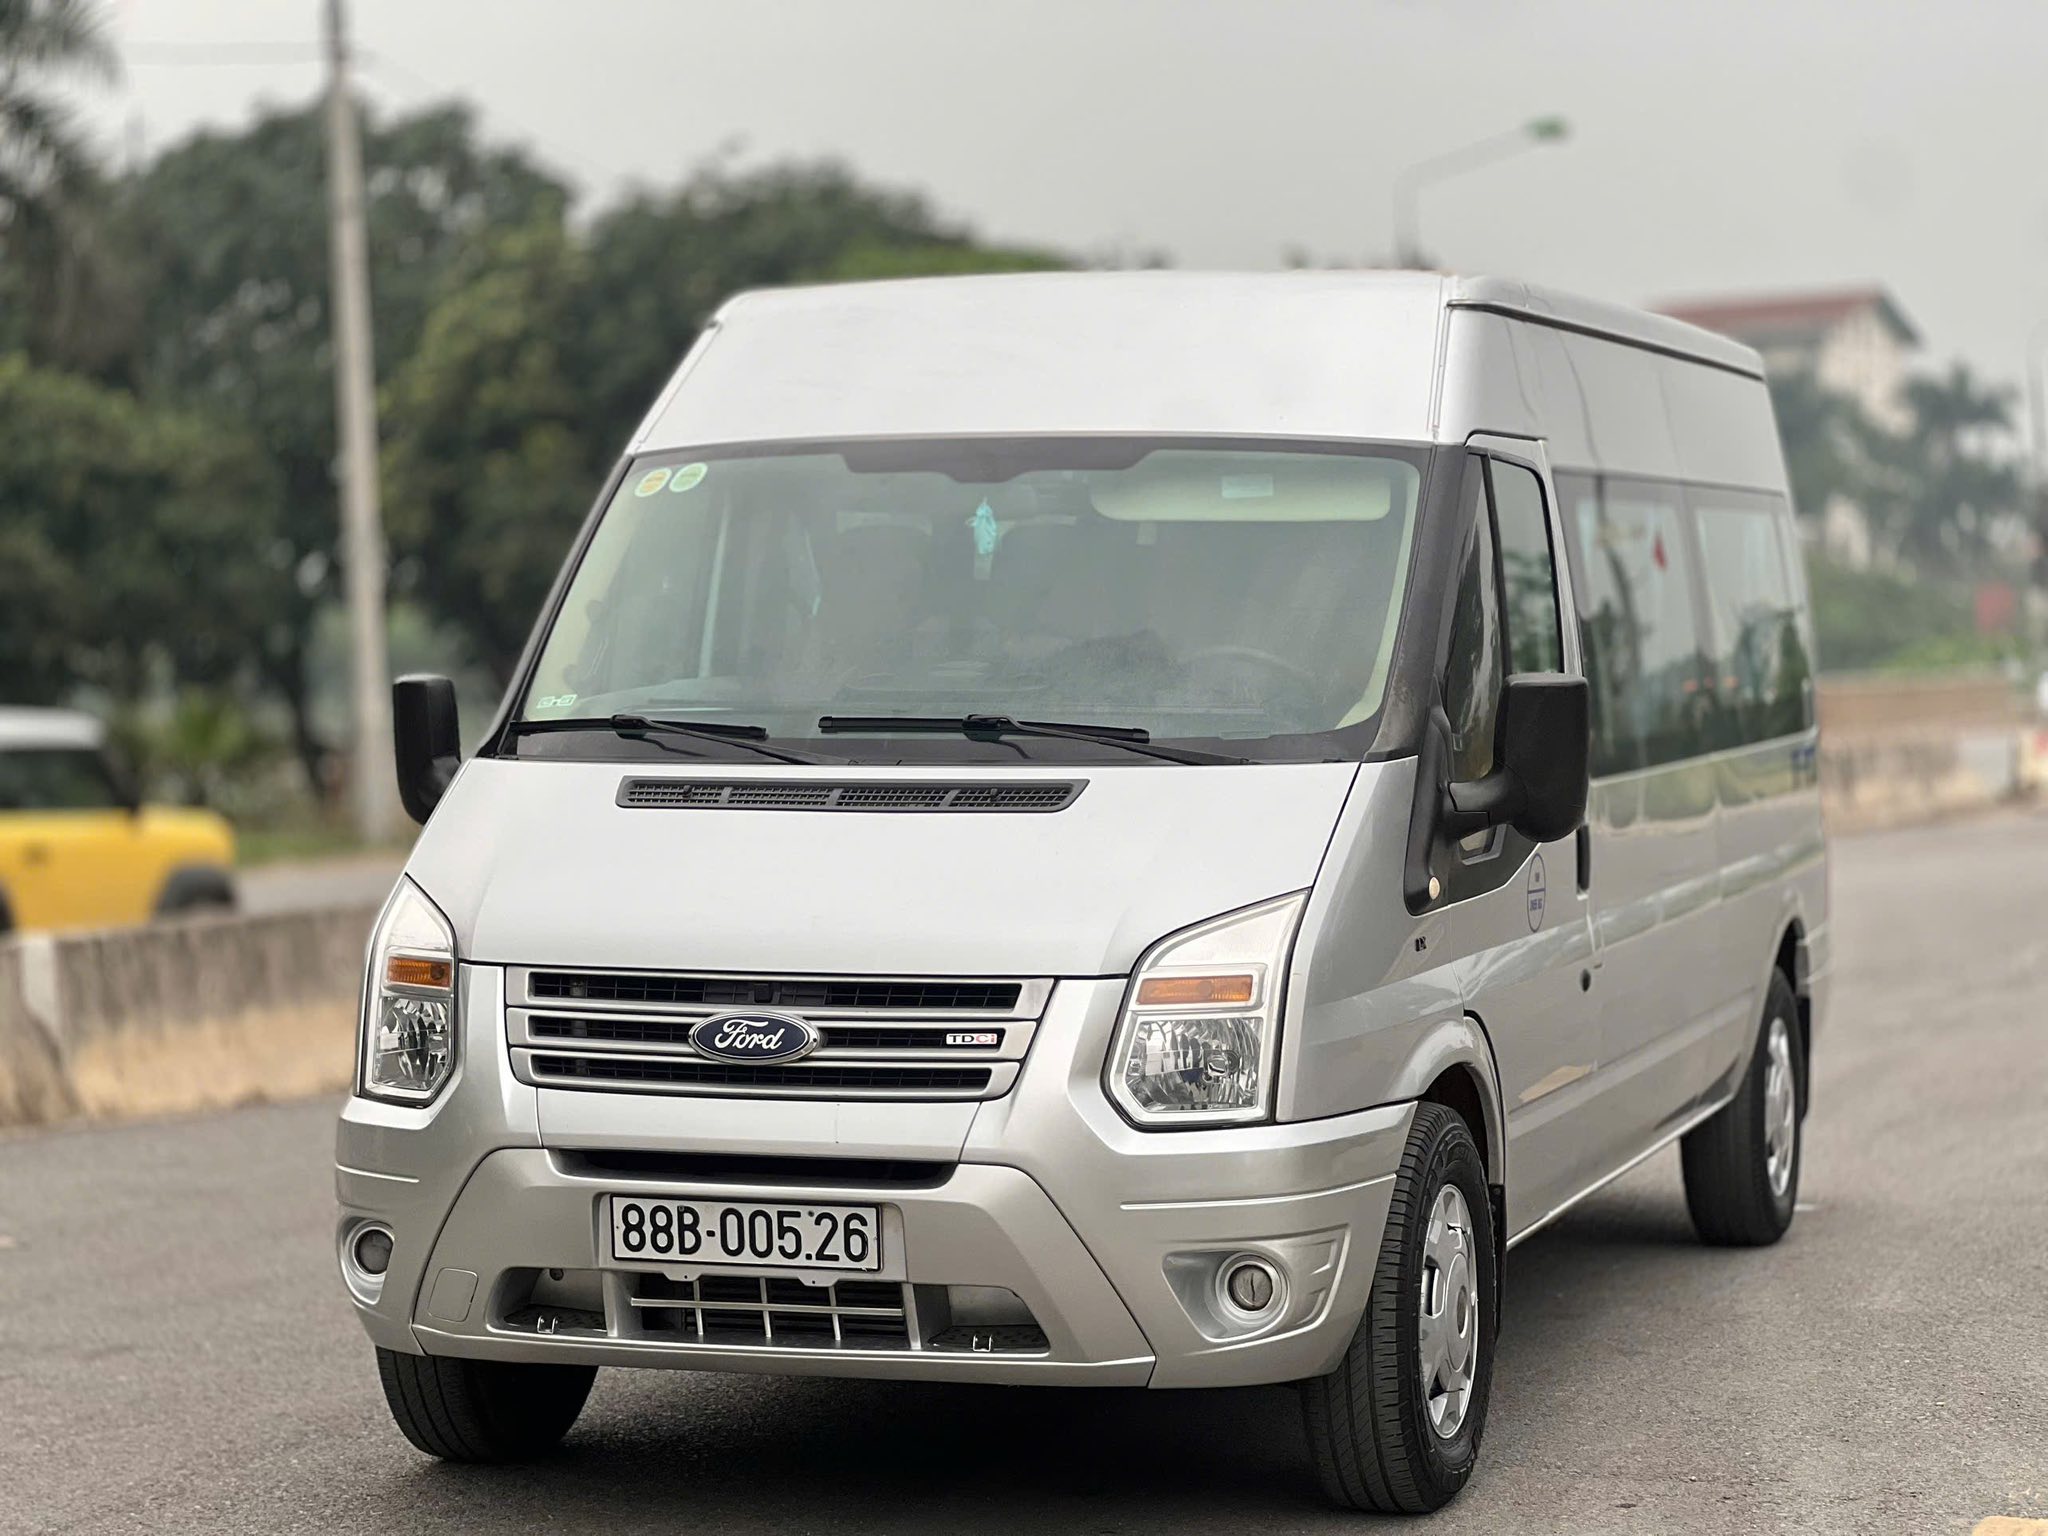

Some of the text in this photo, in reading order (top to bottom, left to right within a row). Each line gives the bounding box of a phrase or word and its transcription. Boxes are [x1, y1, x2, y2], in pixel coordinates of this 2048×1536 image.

[714, 1018, 785, 1050] Ford
[948, 1033, 996, 1045] TDCi
[621, 1203, 869, 1263] 88B-005.26
